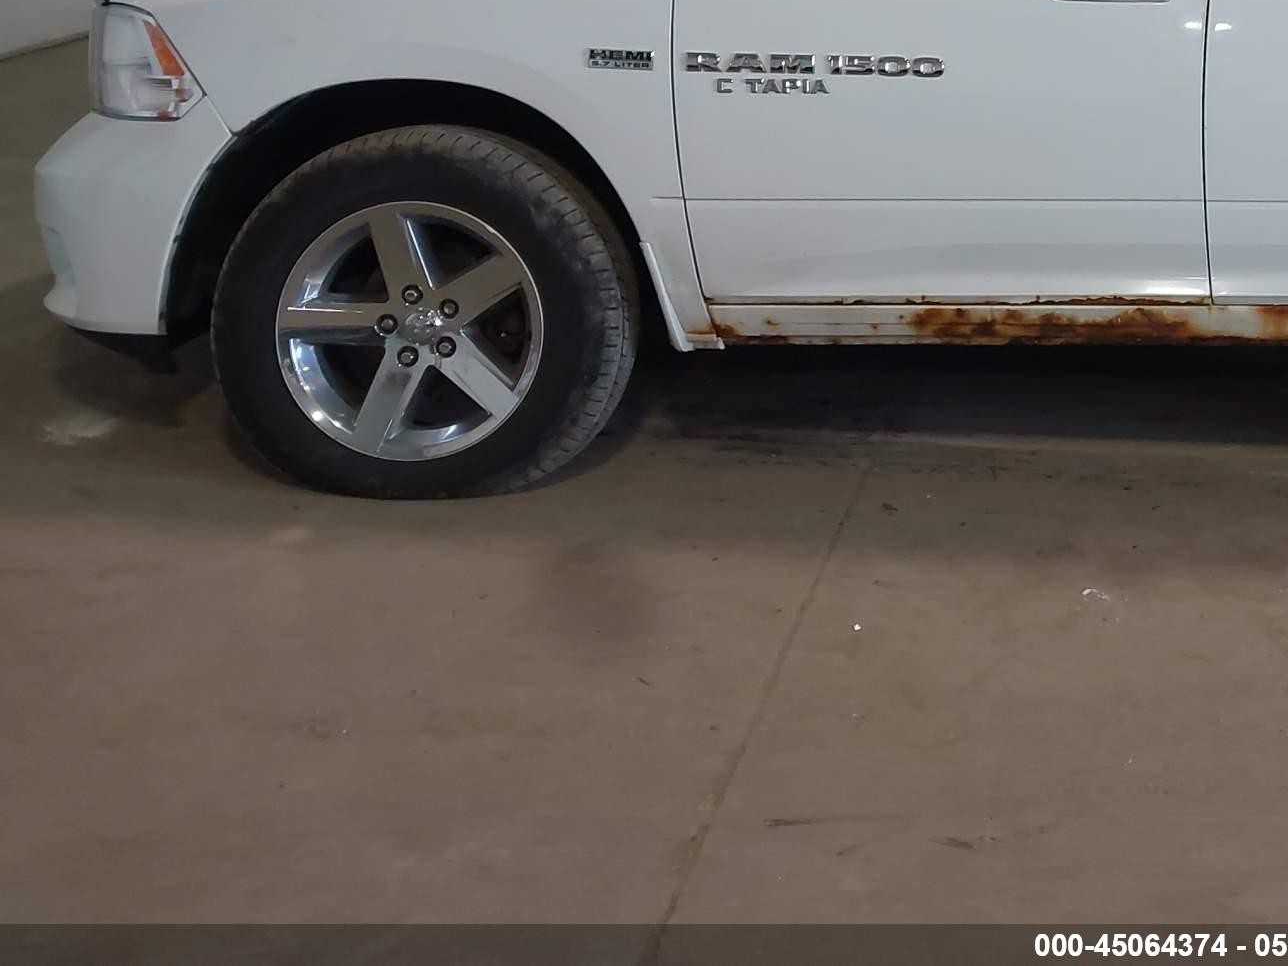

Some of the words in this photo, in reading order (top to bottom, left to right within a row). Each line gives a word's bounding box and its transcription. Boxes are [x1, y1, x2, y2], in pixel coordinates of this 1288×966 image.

[589, 49, 655, 61] HEMI
[614, 61, 650, 69] LITER
[685, 51, 816, 75] RAM
[825, 54, 946, 78] 1500
[716, 78, 734, 94] C
[745, 78, 831, 95] TAPIA
